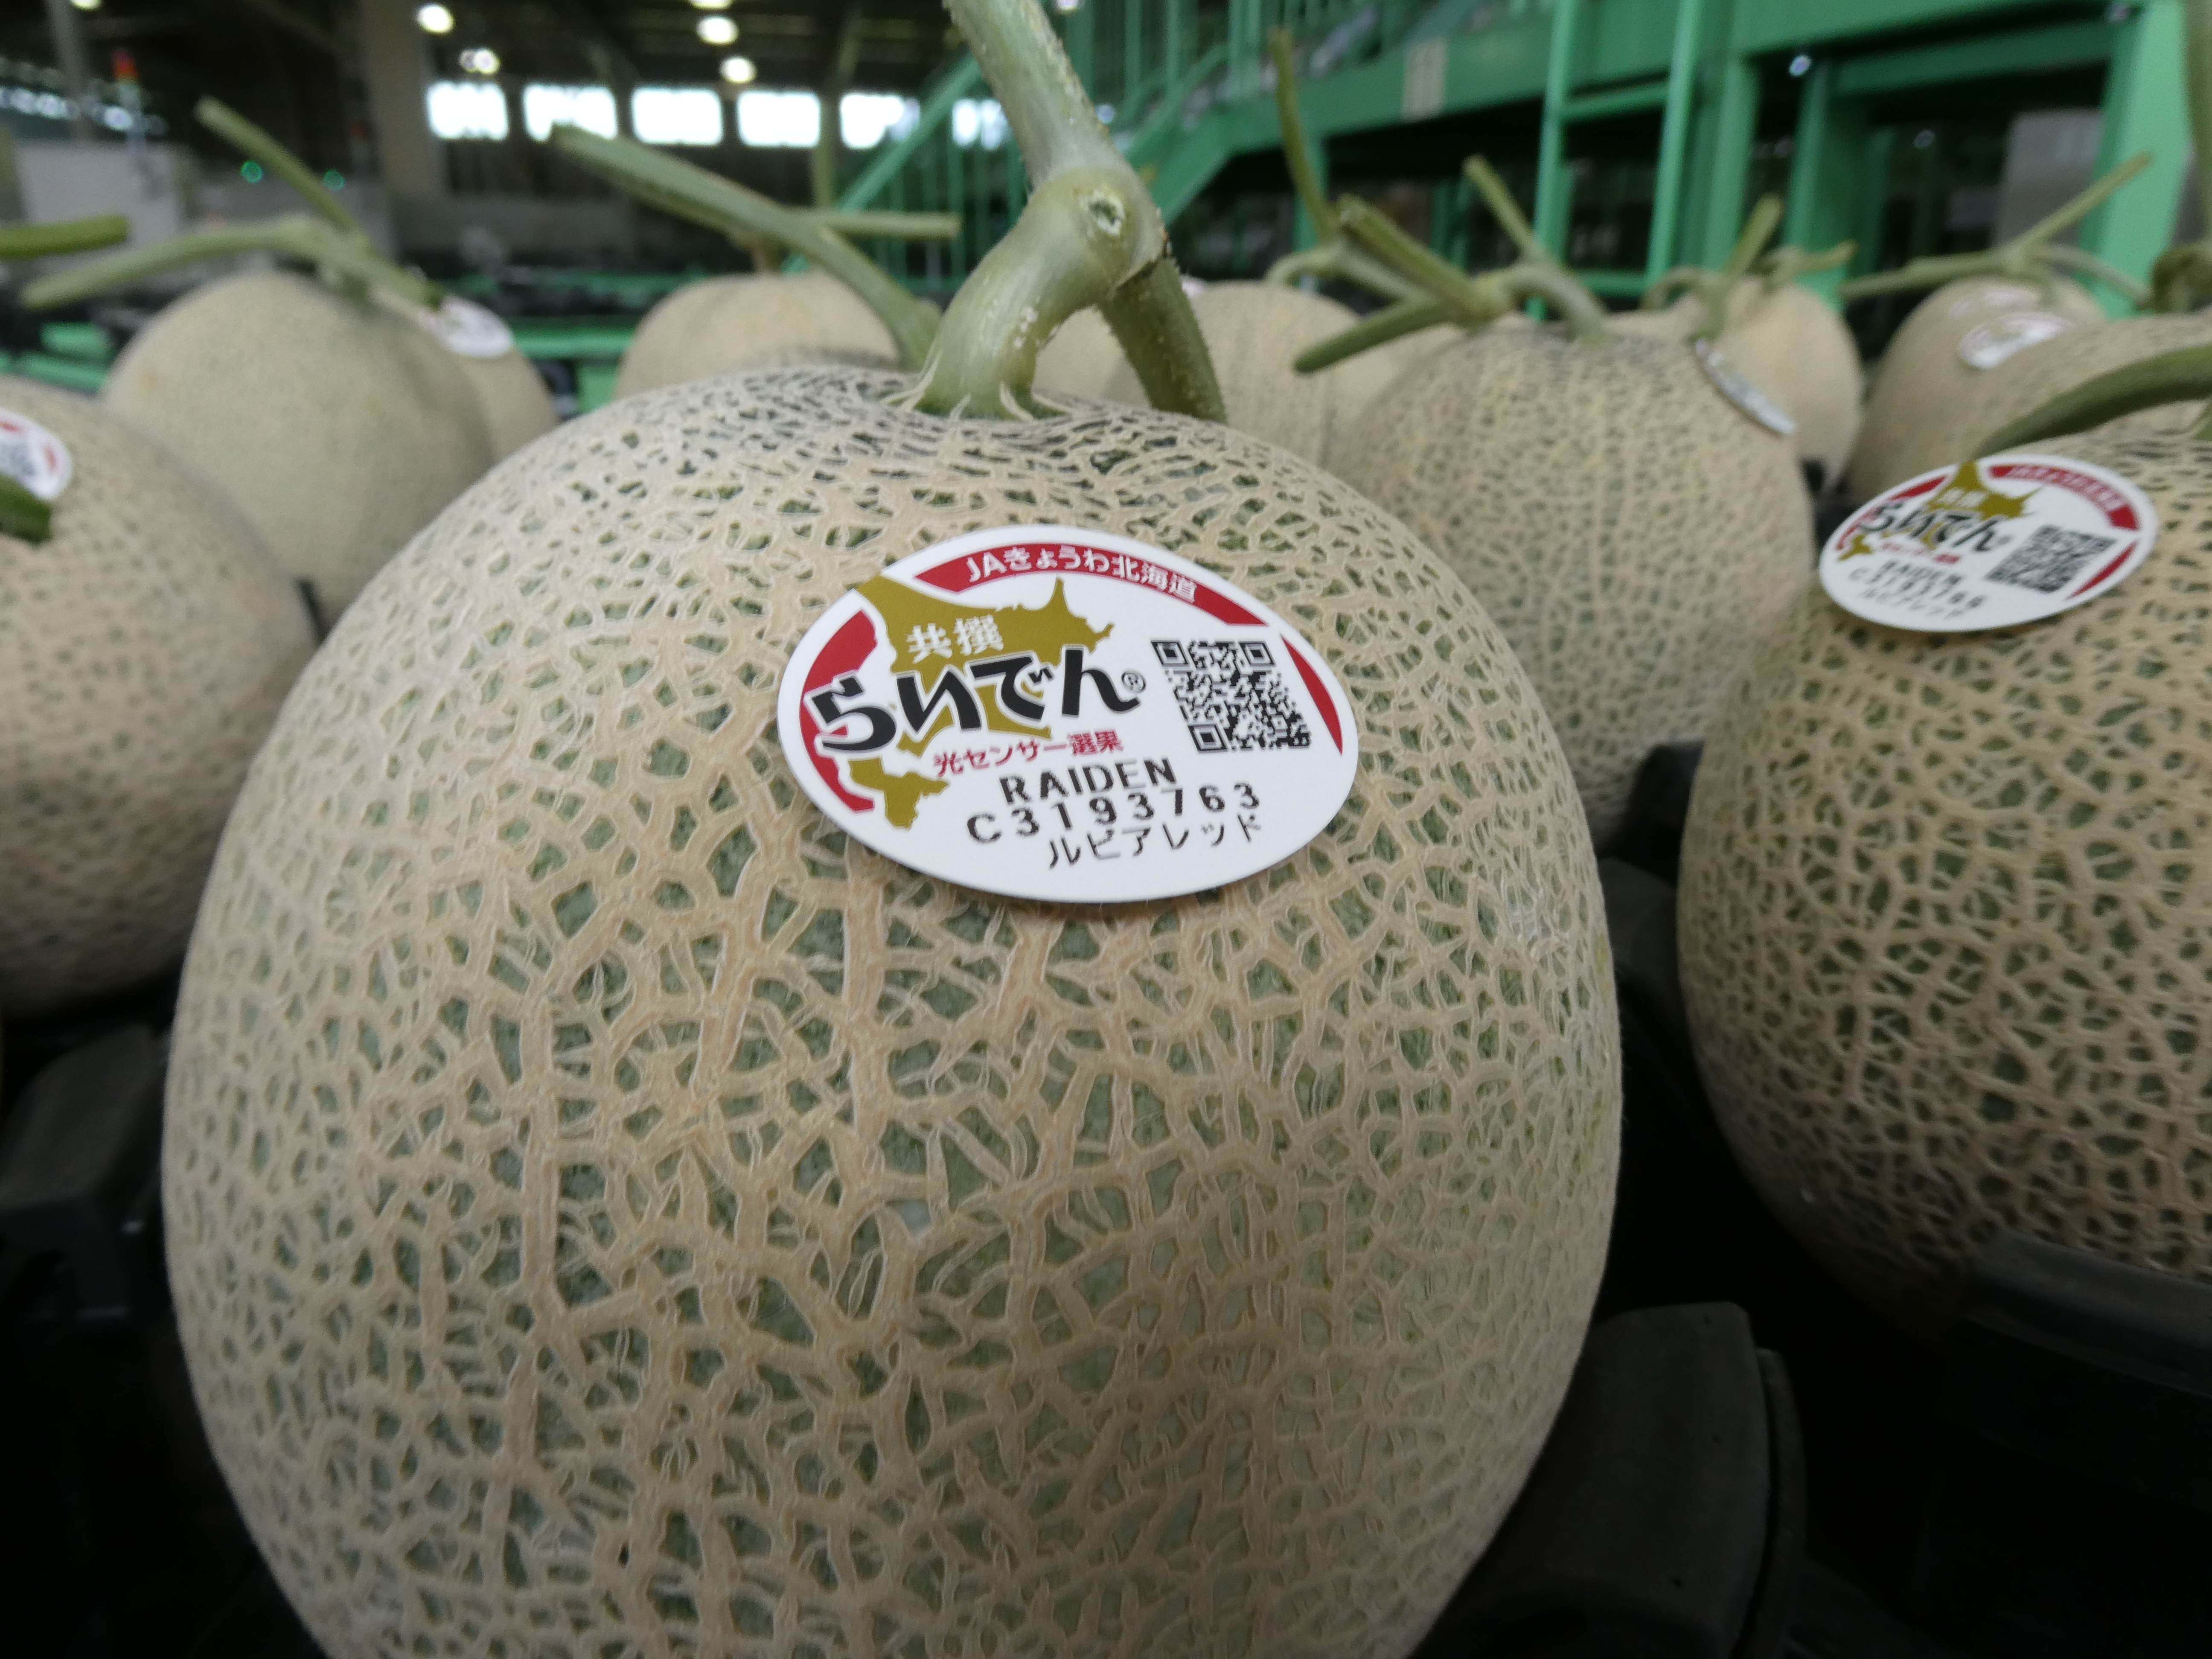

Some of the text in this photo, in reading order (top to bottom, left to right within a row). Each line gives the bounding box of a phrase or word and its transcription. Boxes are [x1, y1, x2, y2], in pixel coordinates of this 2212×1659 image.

[966, 547, 1196, 603] JAきょうわ北海道
[934, 729, 1124, 777] 光センサー選果
[999, 757, 1177, 804] RAIDEN
[966, 782, 1260, 843] C3193763
